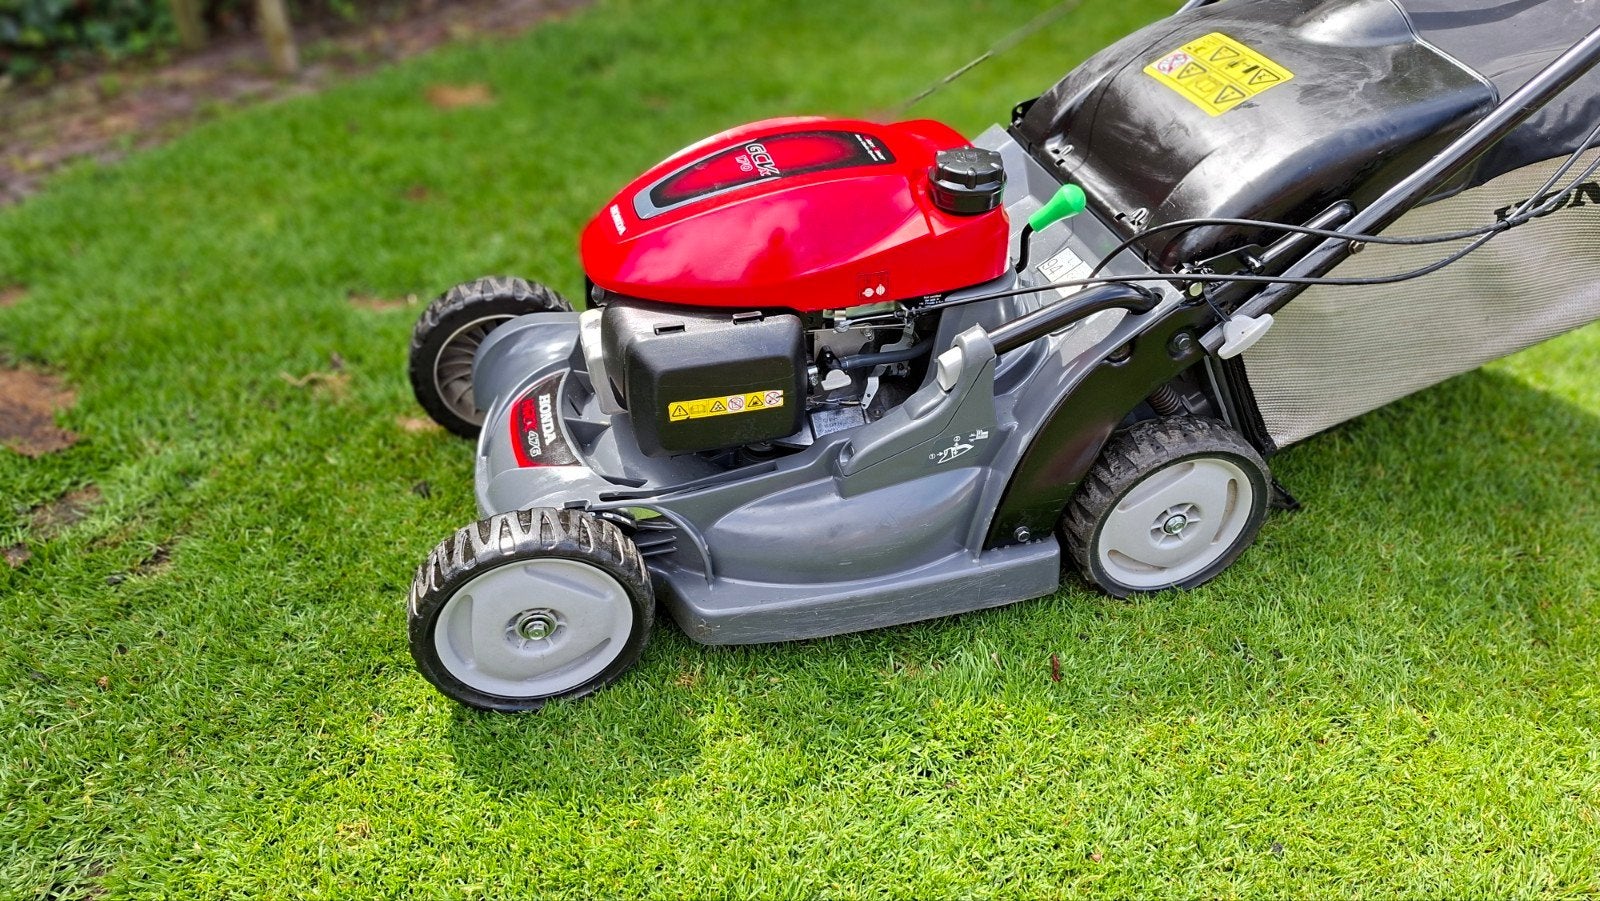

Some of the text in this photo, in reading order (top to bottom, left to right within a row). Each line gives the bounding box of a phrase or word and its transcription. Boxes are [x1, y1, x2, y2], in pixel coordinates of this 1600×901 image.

[610, 203, 627, 237] HONDA
[538, 393, 557, 446] HONDA
[527, 430, 542, 458] 476
